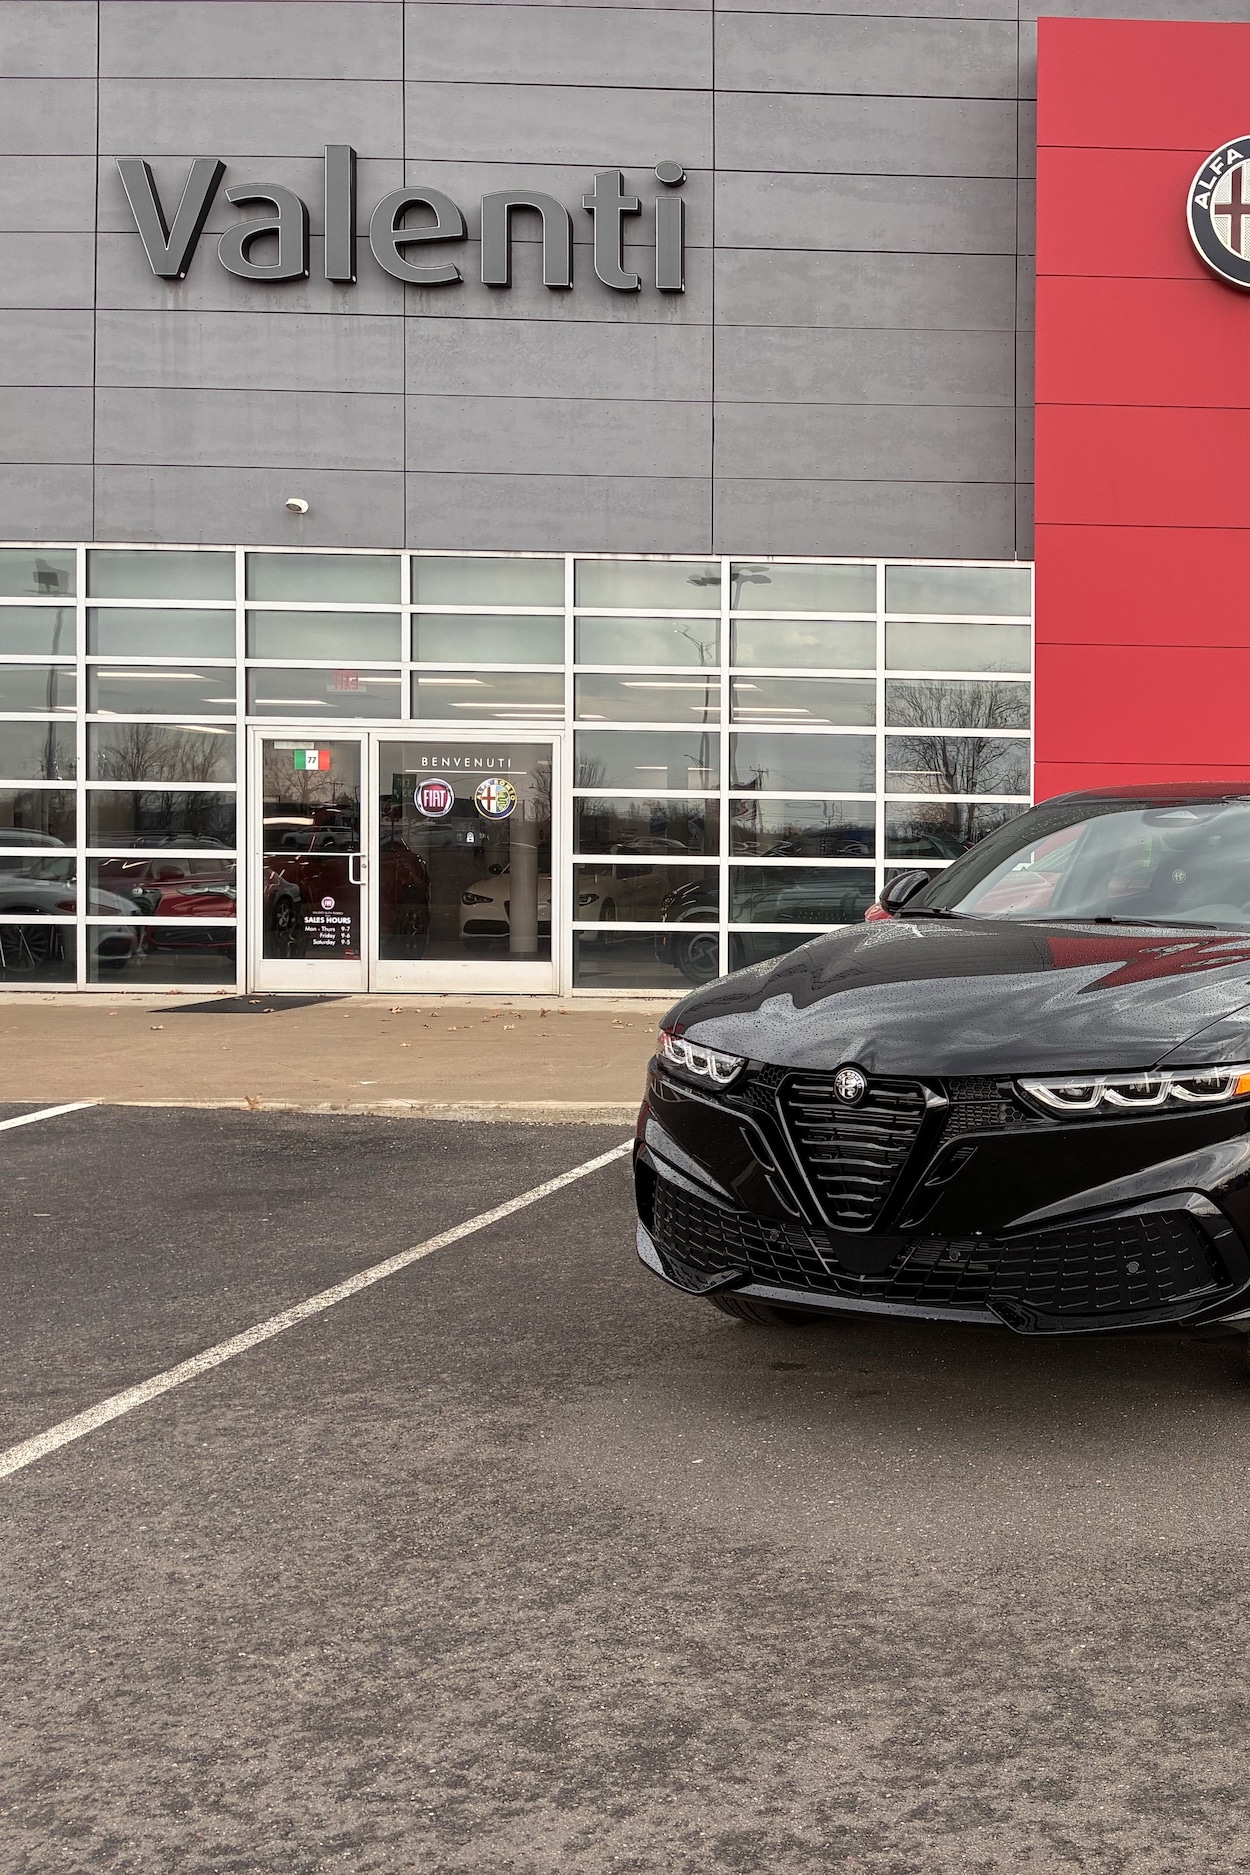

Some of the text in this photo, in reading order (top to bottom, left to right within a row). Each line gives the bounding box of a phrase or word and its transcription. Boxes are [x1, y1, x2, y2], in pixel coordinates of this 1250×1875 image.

[1194, 148, 1244, 210] ALFA
[115, 144, 687, 293] Valenti
[307, 756, 317, 764] 77
[421, 757, 512, 768] BENVENUTI
[423, 789, 446, 808] FIAT
